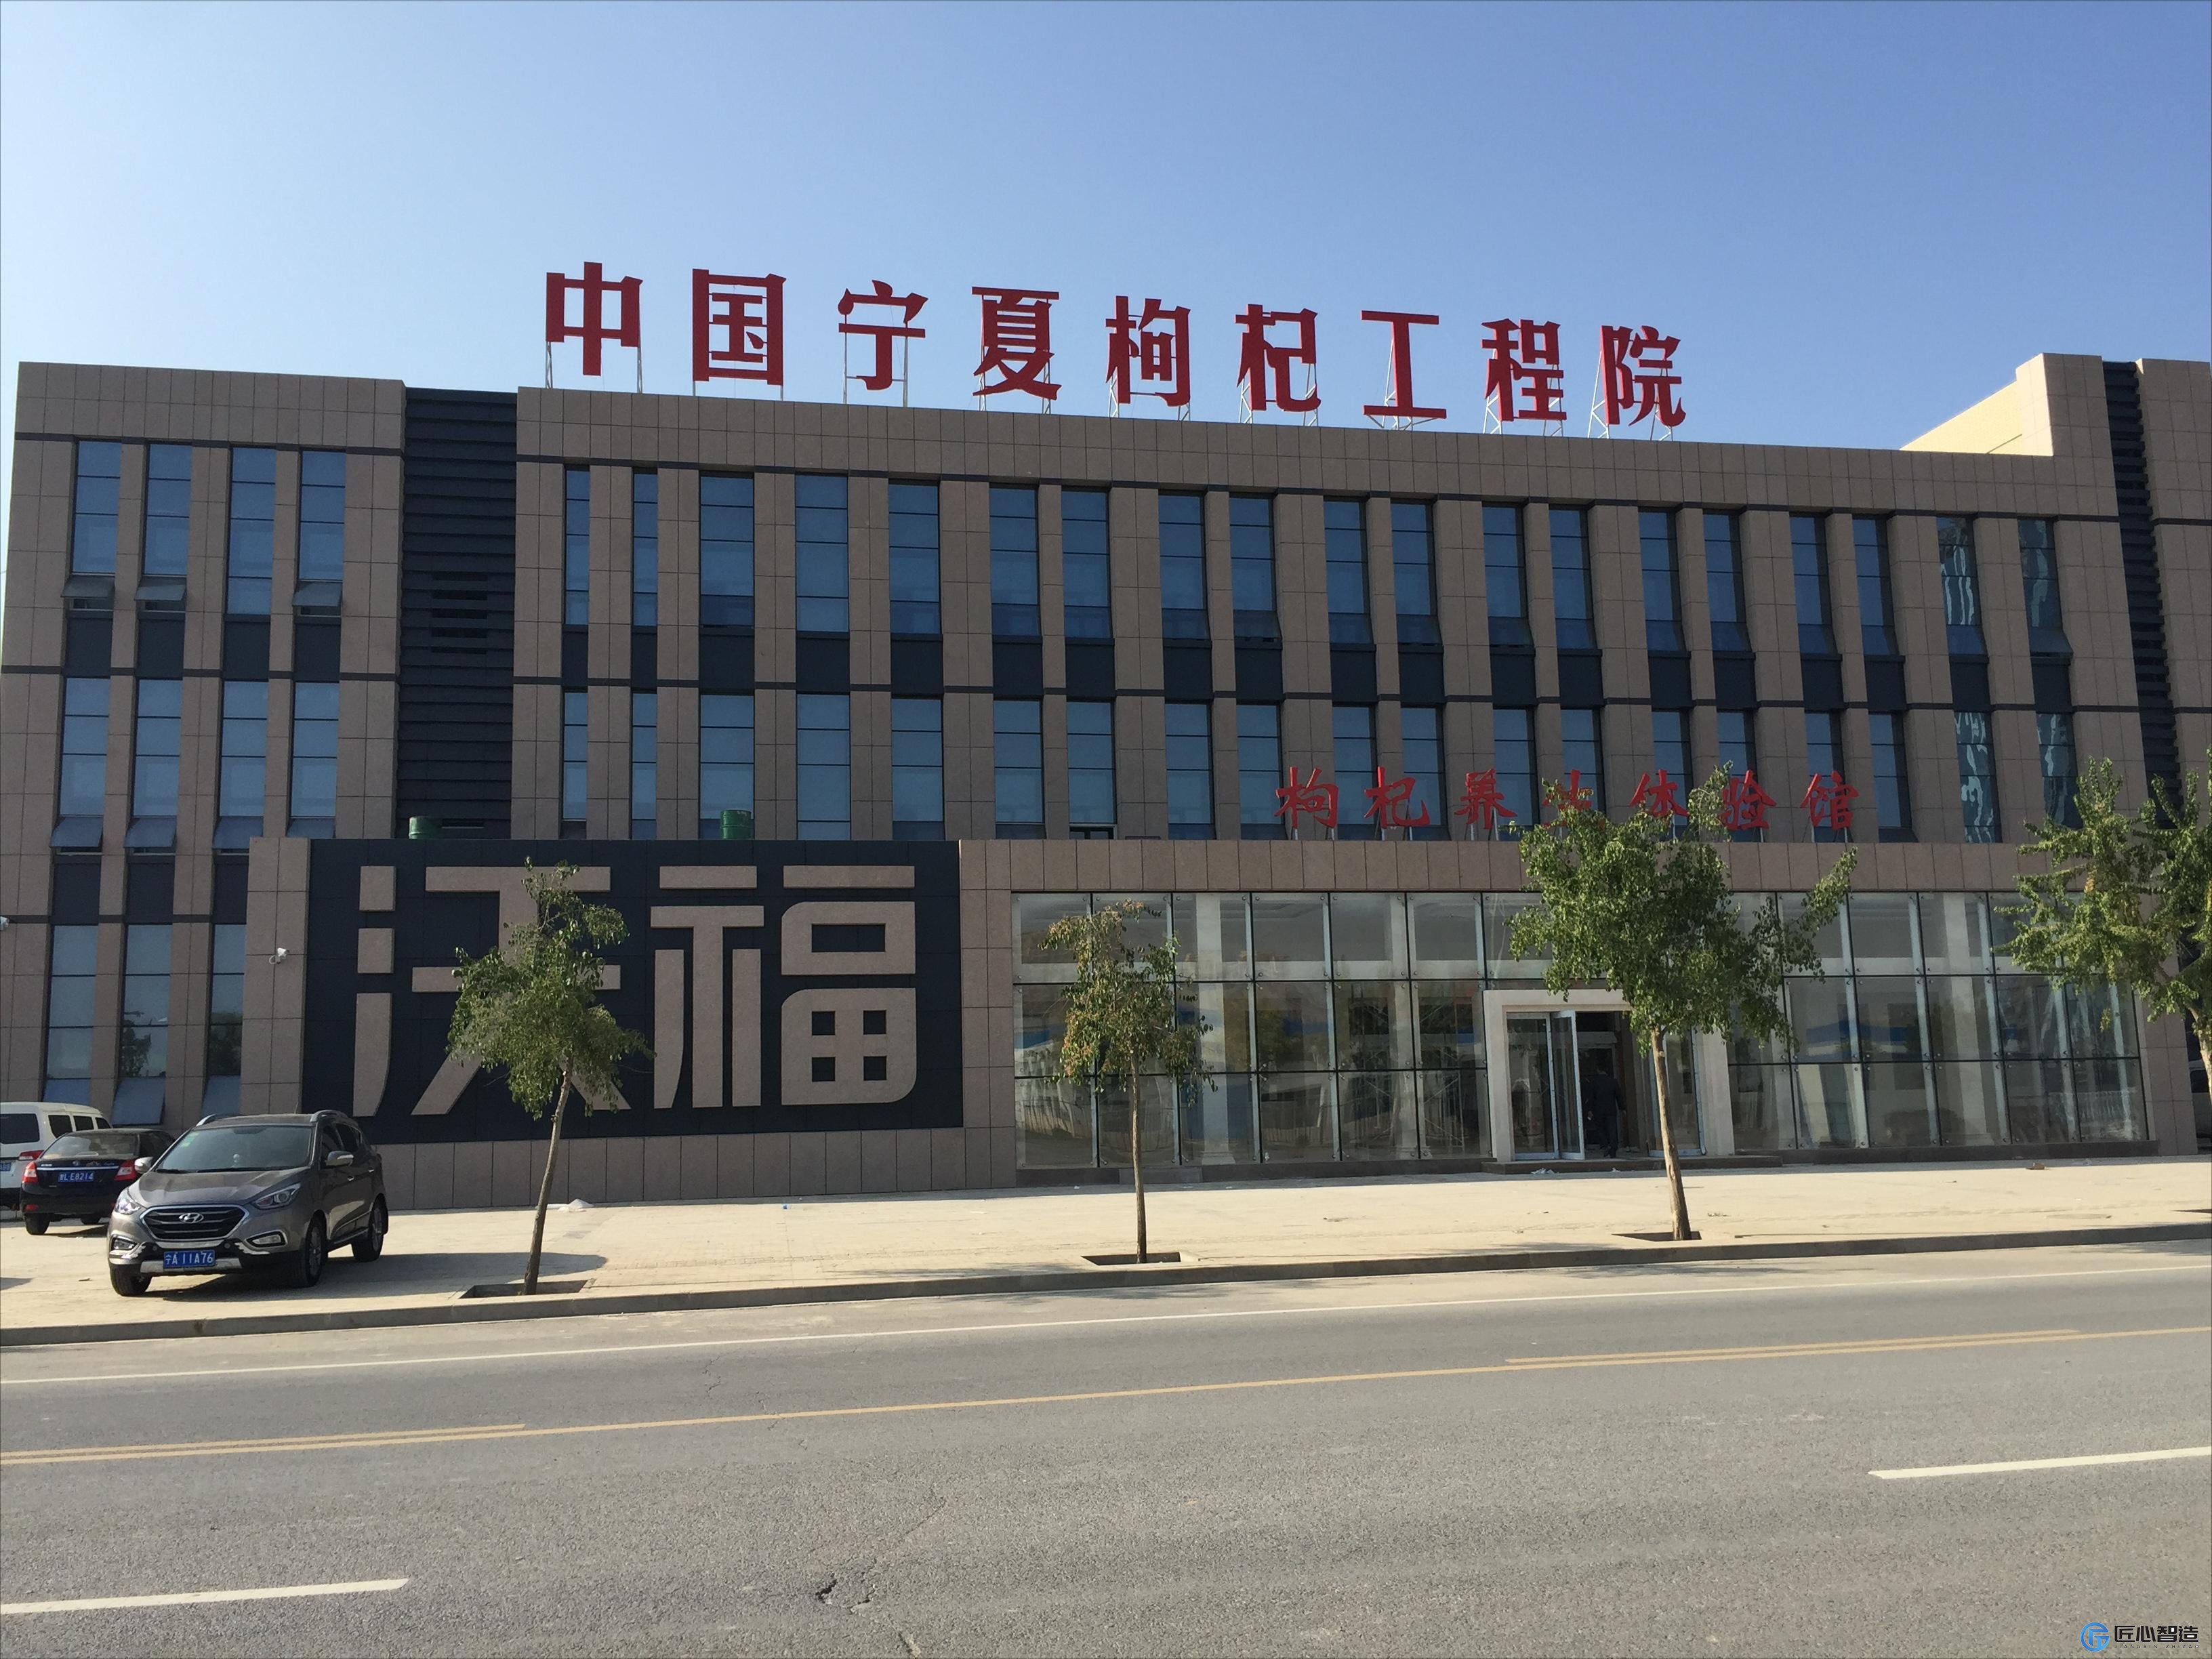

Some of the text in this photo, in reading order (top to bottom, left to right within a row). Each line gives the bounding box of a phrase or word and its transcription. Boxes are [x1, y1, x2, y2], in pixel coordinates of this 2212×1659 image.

[546, 262, 1684, 428] 中国宁夏枸杞工程院
